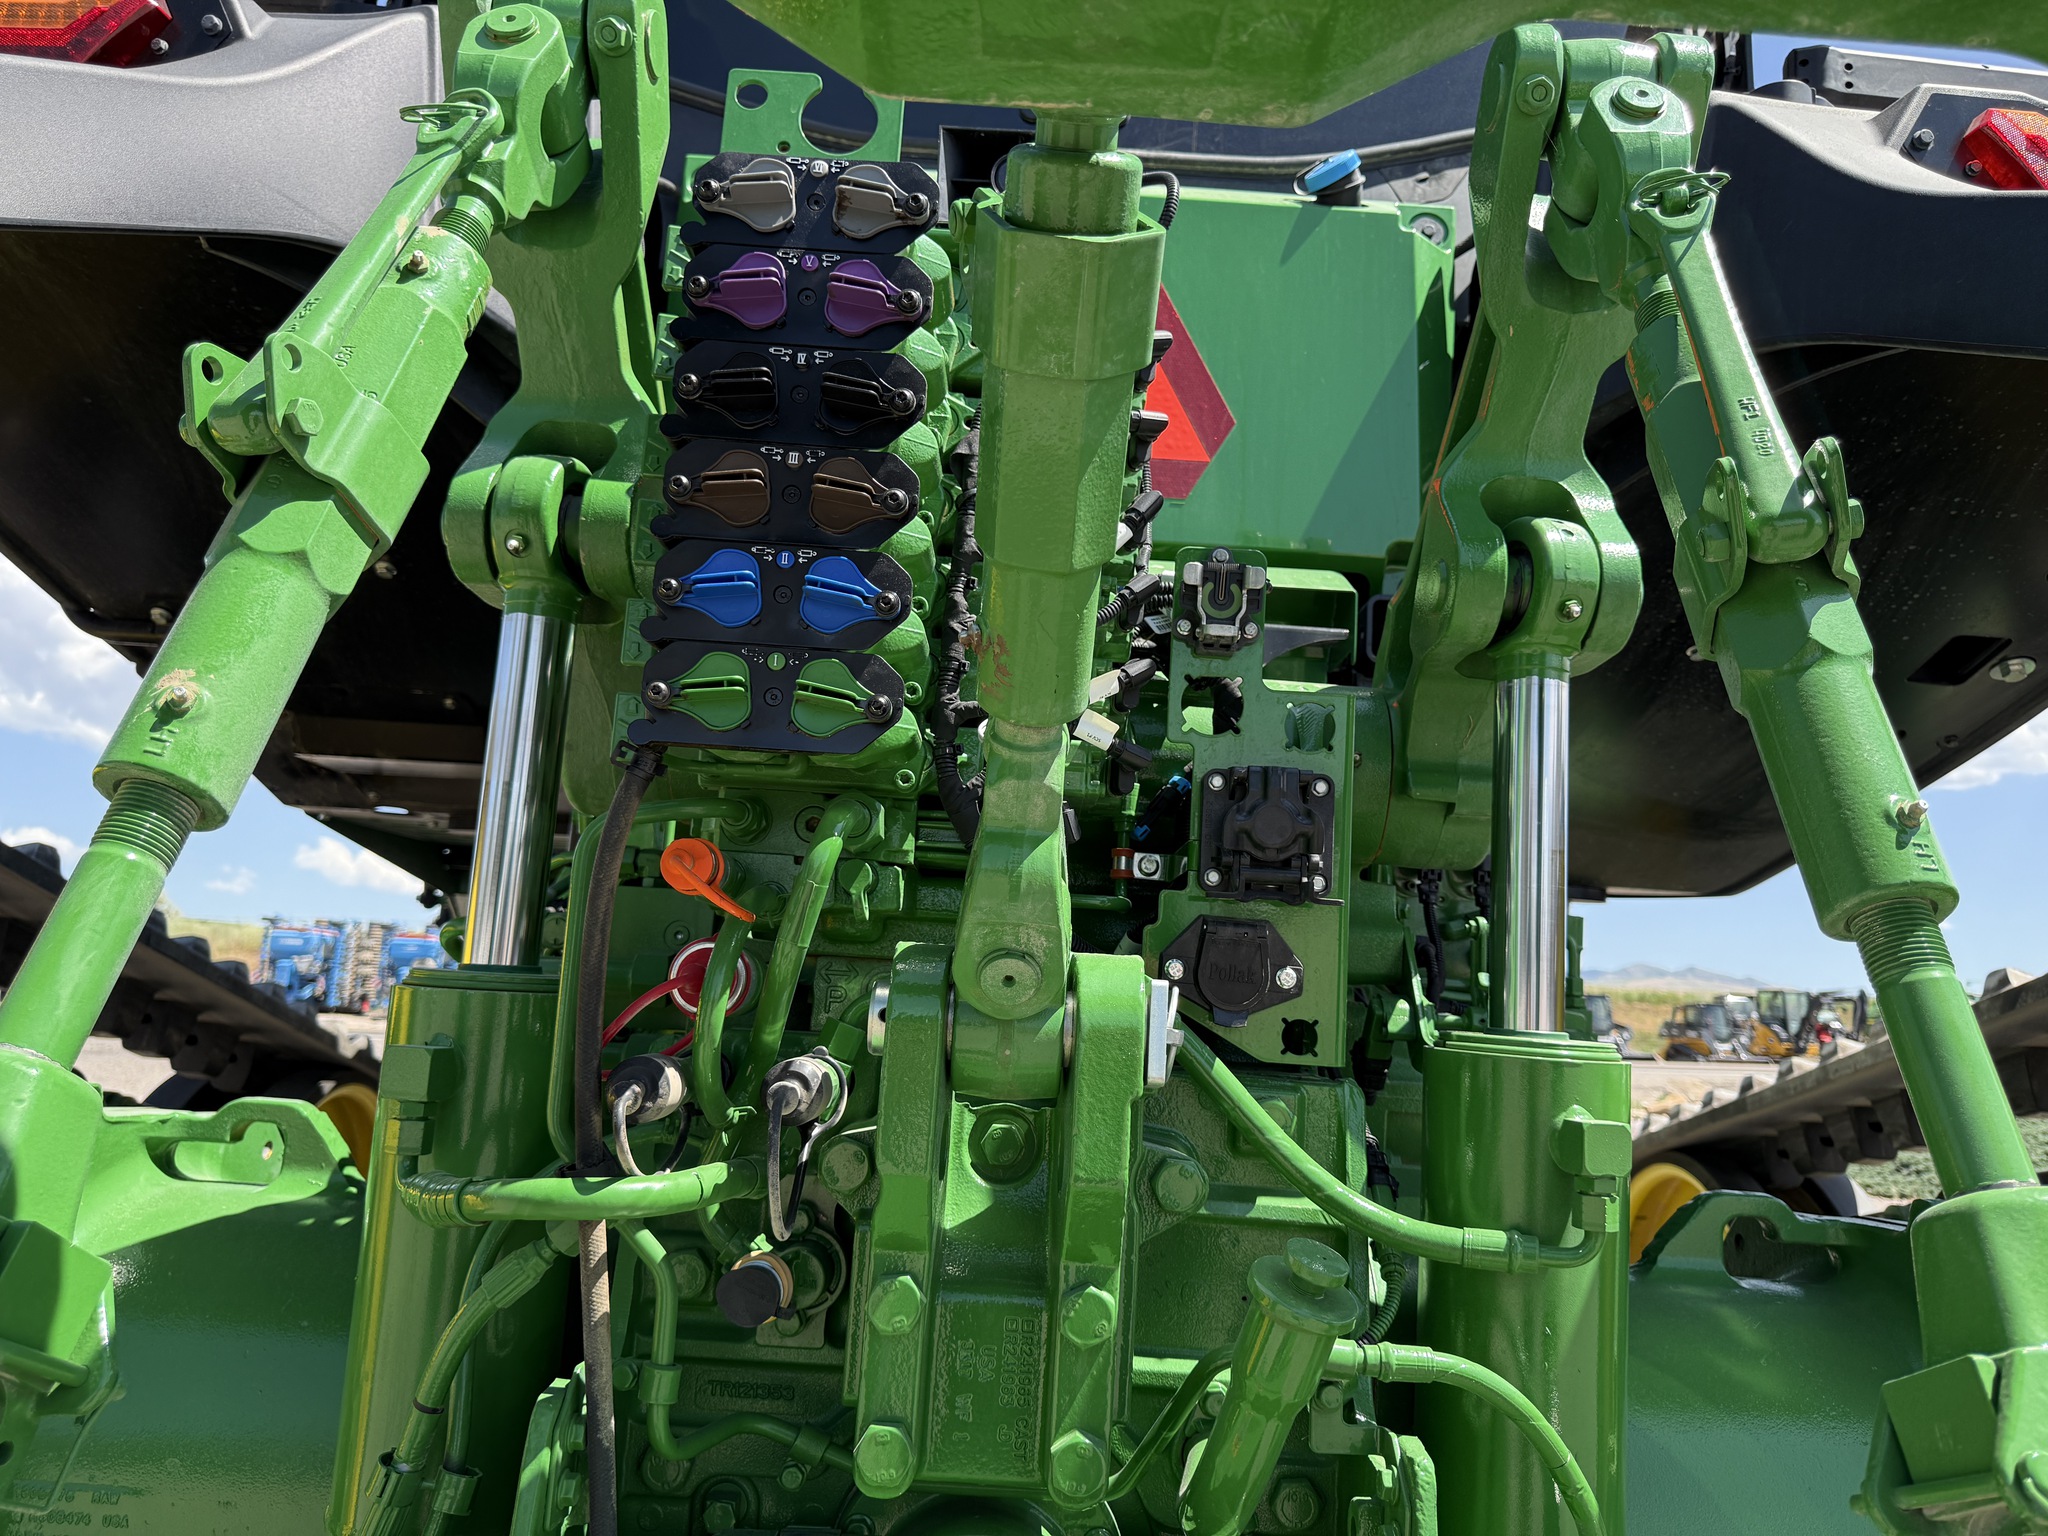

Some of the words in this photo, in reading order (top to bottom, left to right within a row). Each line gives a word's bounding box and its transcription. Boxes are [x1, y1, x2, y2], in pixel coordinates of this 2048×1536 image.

[804, 255, 814, 267] V
[796, 353, 807, 365] IV
[788, 452, 800, 464] III
[781, 552, 789, 565] II
[1208, 962, 1257, 985] Pollak
[824, 985, 848, 1014] P
[977, 1344, 998, 1383] USA
[707, 1380, 796, 1401] TR121353
[1012, 1416, 1031, 1461] CAST
